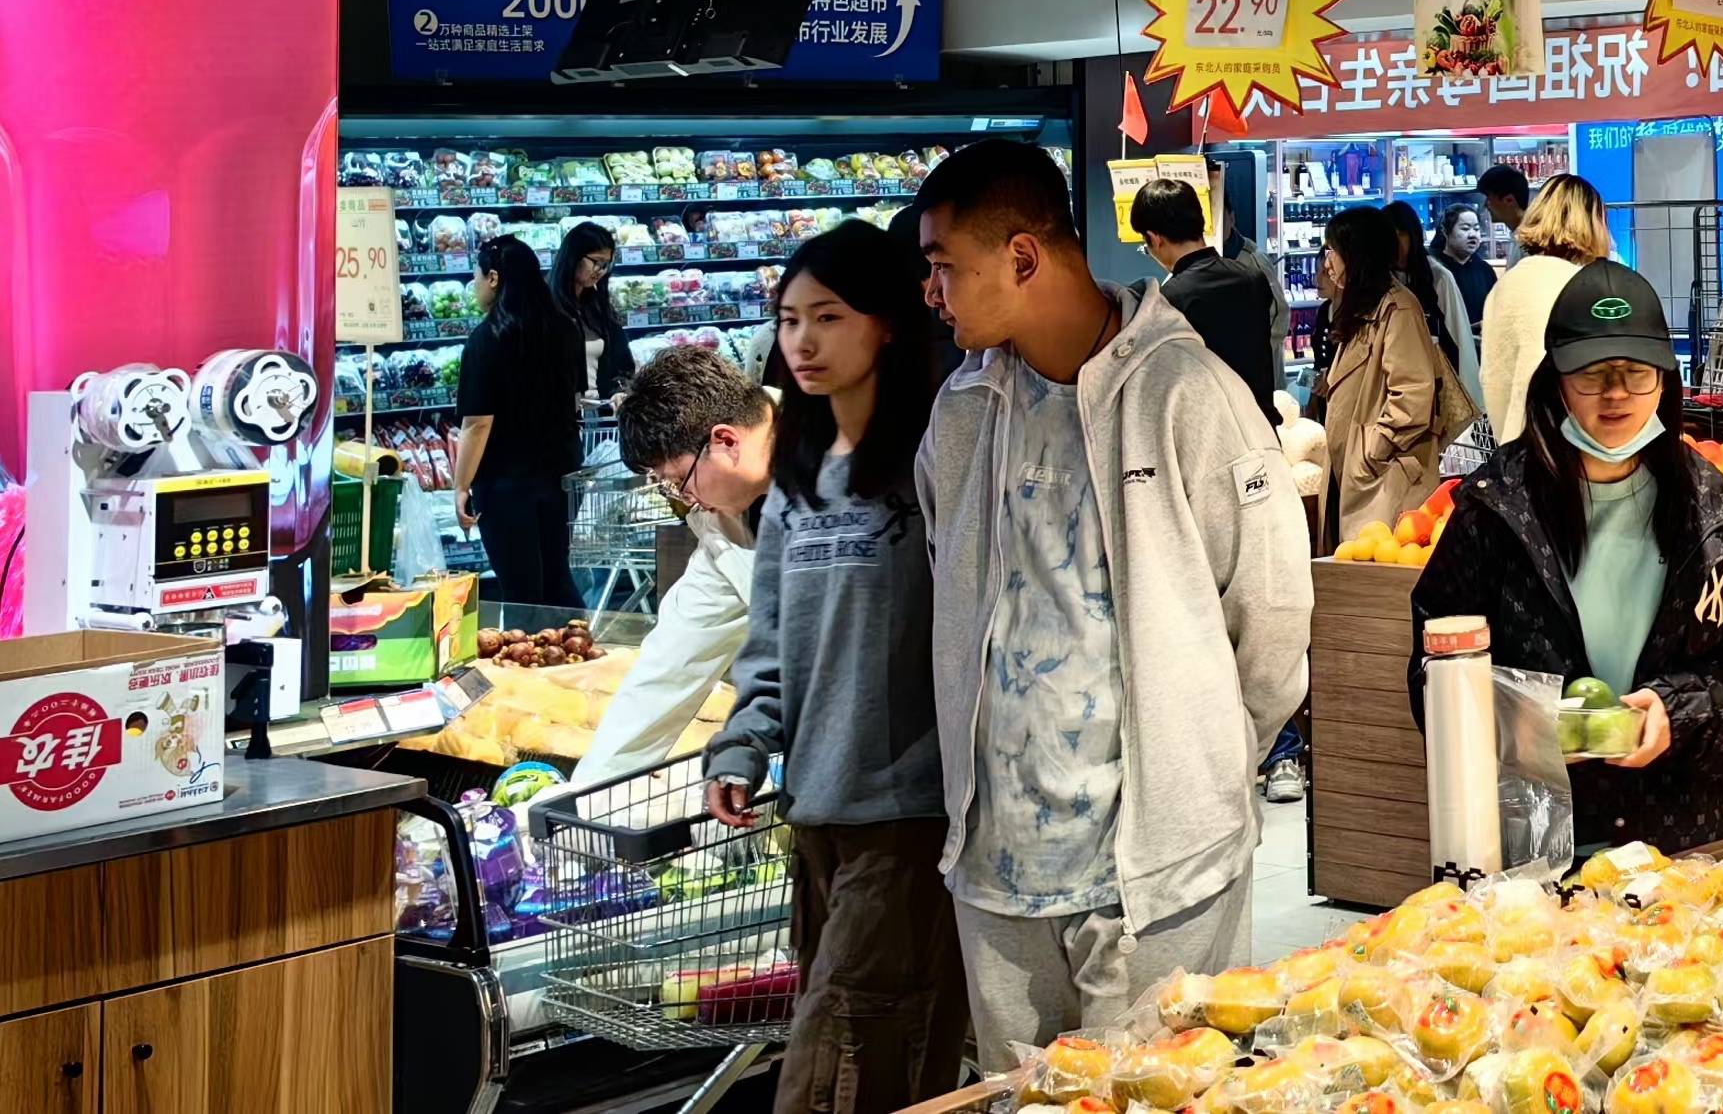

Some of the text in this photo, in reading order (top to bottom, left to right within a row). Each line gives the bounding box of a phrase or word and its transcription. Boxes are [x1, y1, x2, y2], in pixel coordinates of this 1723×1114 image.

[439, 23, 533, 37] 万种商品精选上架
[416, 39, 545, 52] 一站式满足家庭生活需求
[1194, 62, 1281, 74] 东北人的家庭采购员
[336, 247, 387, 279] 25.90
[16, 723, 103, 779] 佳农
